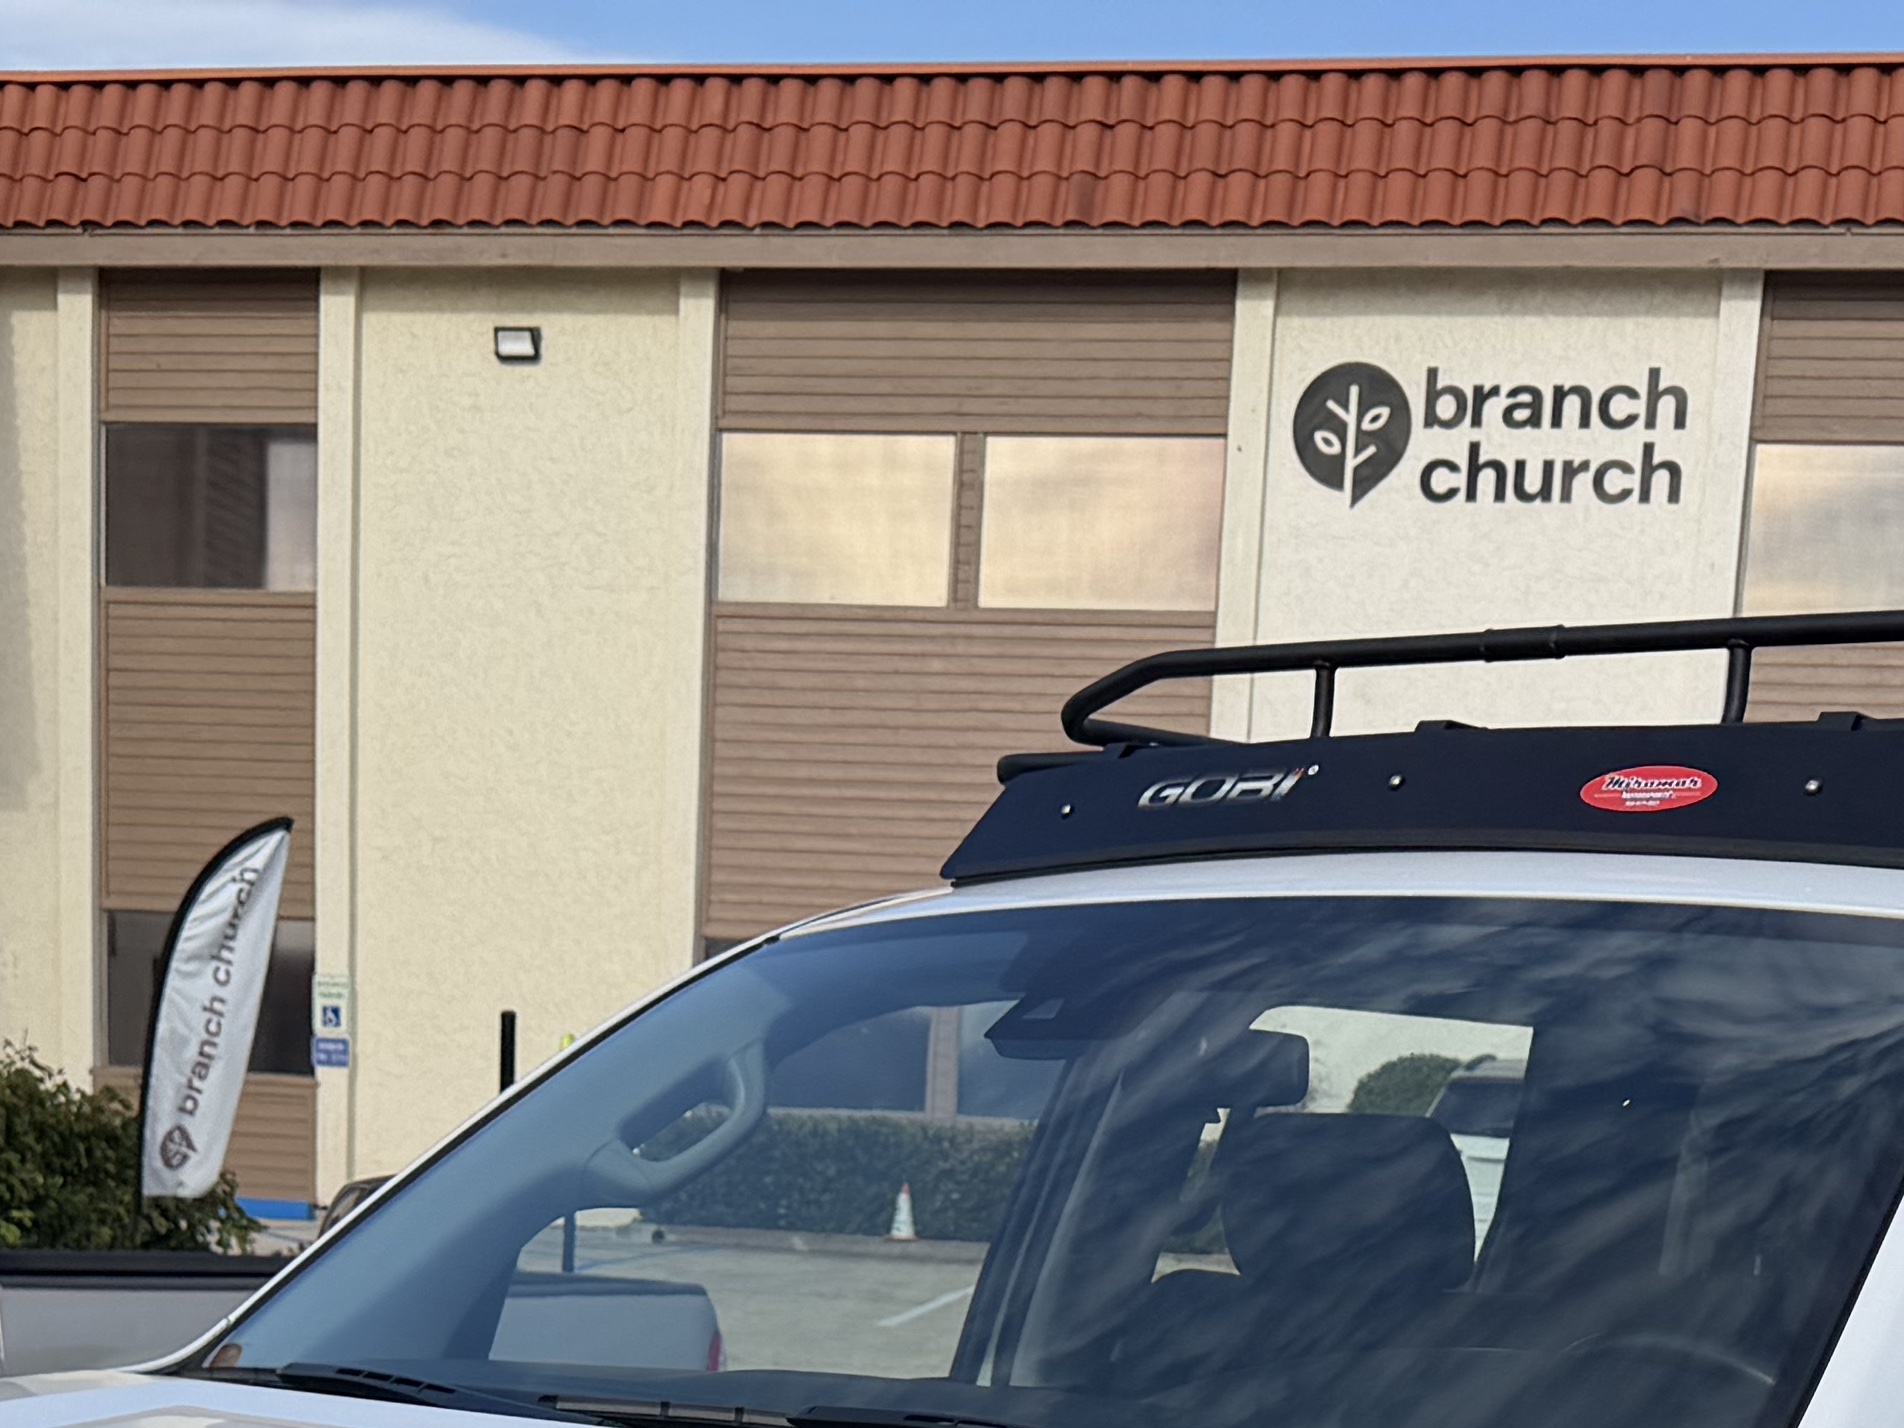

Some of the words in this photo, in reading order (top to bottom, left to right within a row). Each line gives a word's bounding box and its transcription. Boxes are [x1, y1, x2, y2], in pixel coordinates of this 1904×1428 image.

[1423, 366, 1688, 430] branch
[1420, 441, 1683, 504] church
[178, 994, 227, 1116] branch
[209, 866, 260, 989] church
